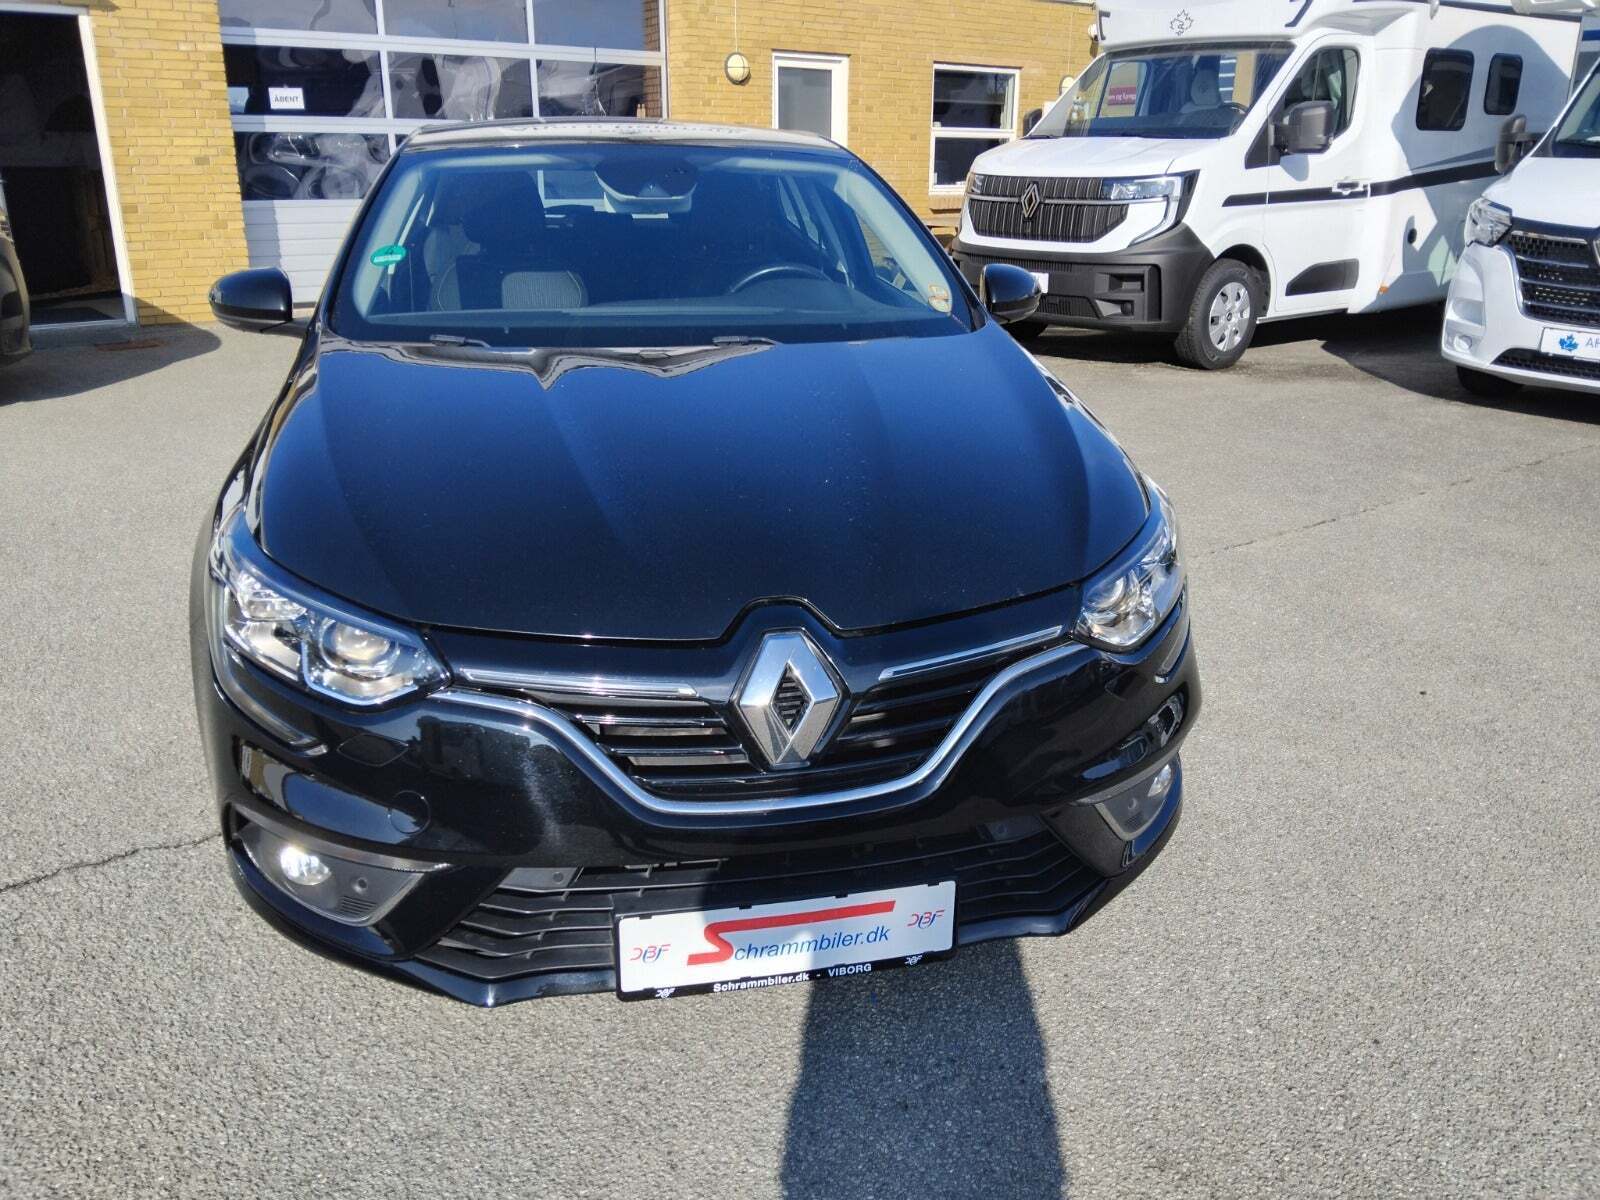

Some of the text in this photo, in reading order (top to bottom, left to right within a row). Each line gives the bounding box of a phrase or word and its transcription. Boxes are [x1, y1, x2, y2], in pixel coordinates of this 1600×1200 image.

[687, 900, 896, 966] Schrammbiler.dk
[713, 972, 810, 993] Schrammbiler.dk
[828, 963, 872, 978] VIBORG
